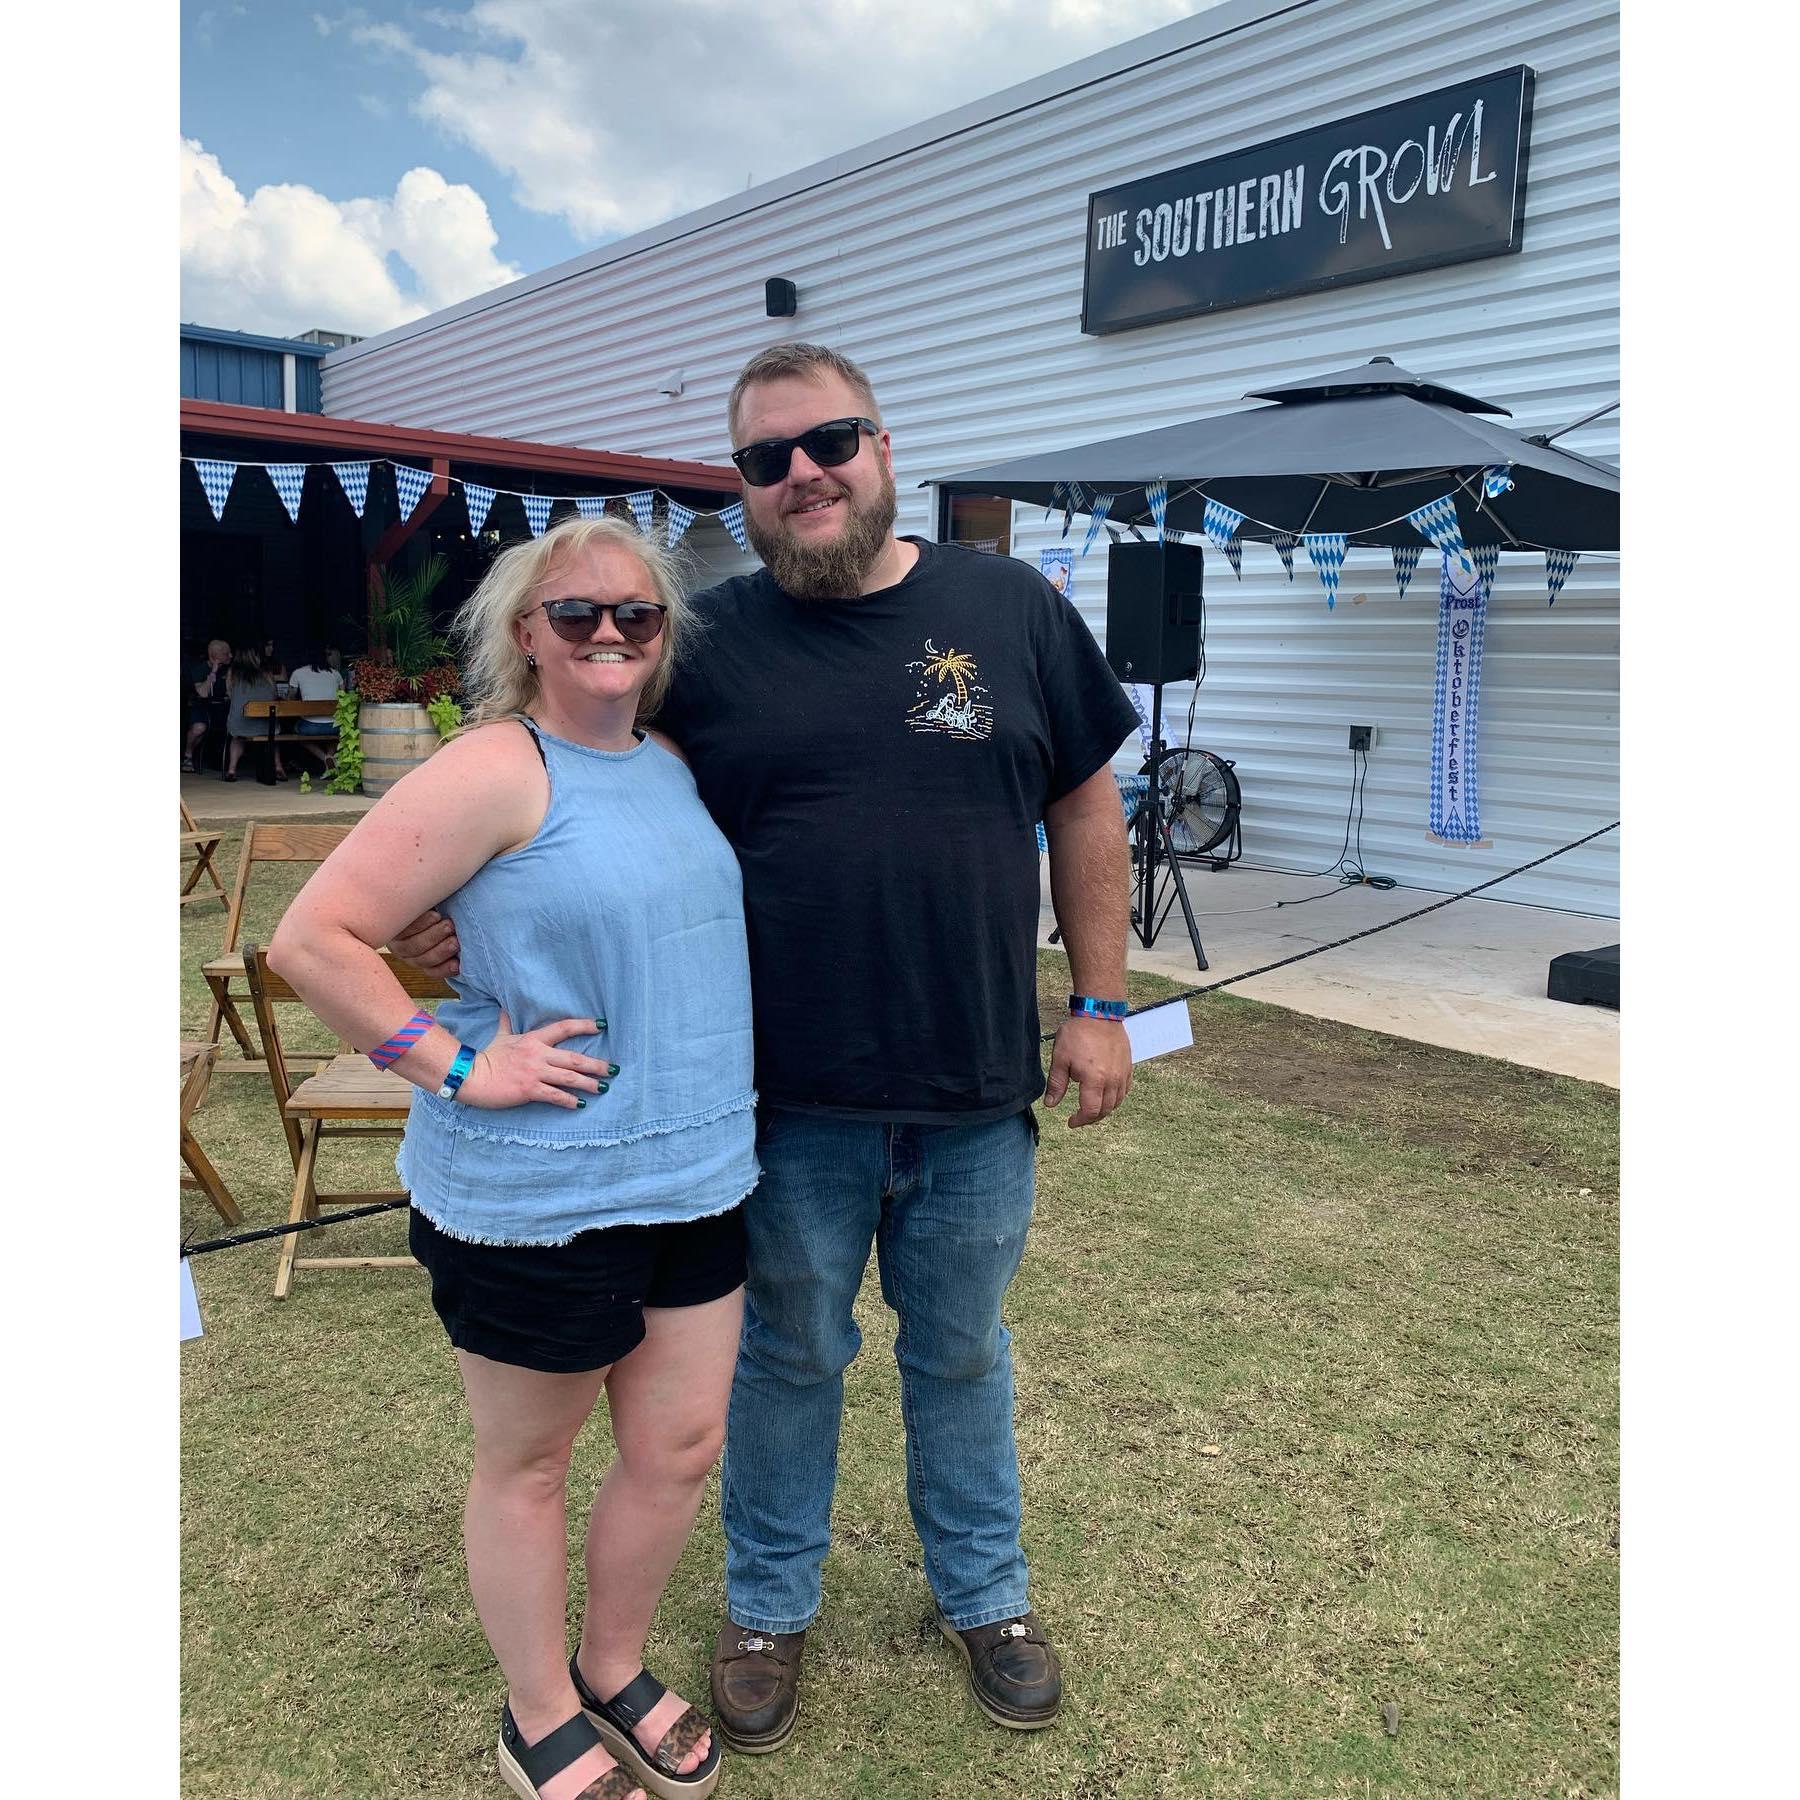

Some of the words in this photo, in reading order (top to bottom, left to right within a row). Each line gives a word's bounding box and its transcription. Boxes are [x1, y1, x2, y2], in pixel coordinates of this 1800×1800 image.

[1097, 209, 1128, 251] THE
[1134, 164, 1305, 267] SOUTHERN
[1318, 98, 1497, 251] GROWL
[1445, 594, 1481, 610] Prost
[1448, 618, 1470, 802] Oktoberfest
